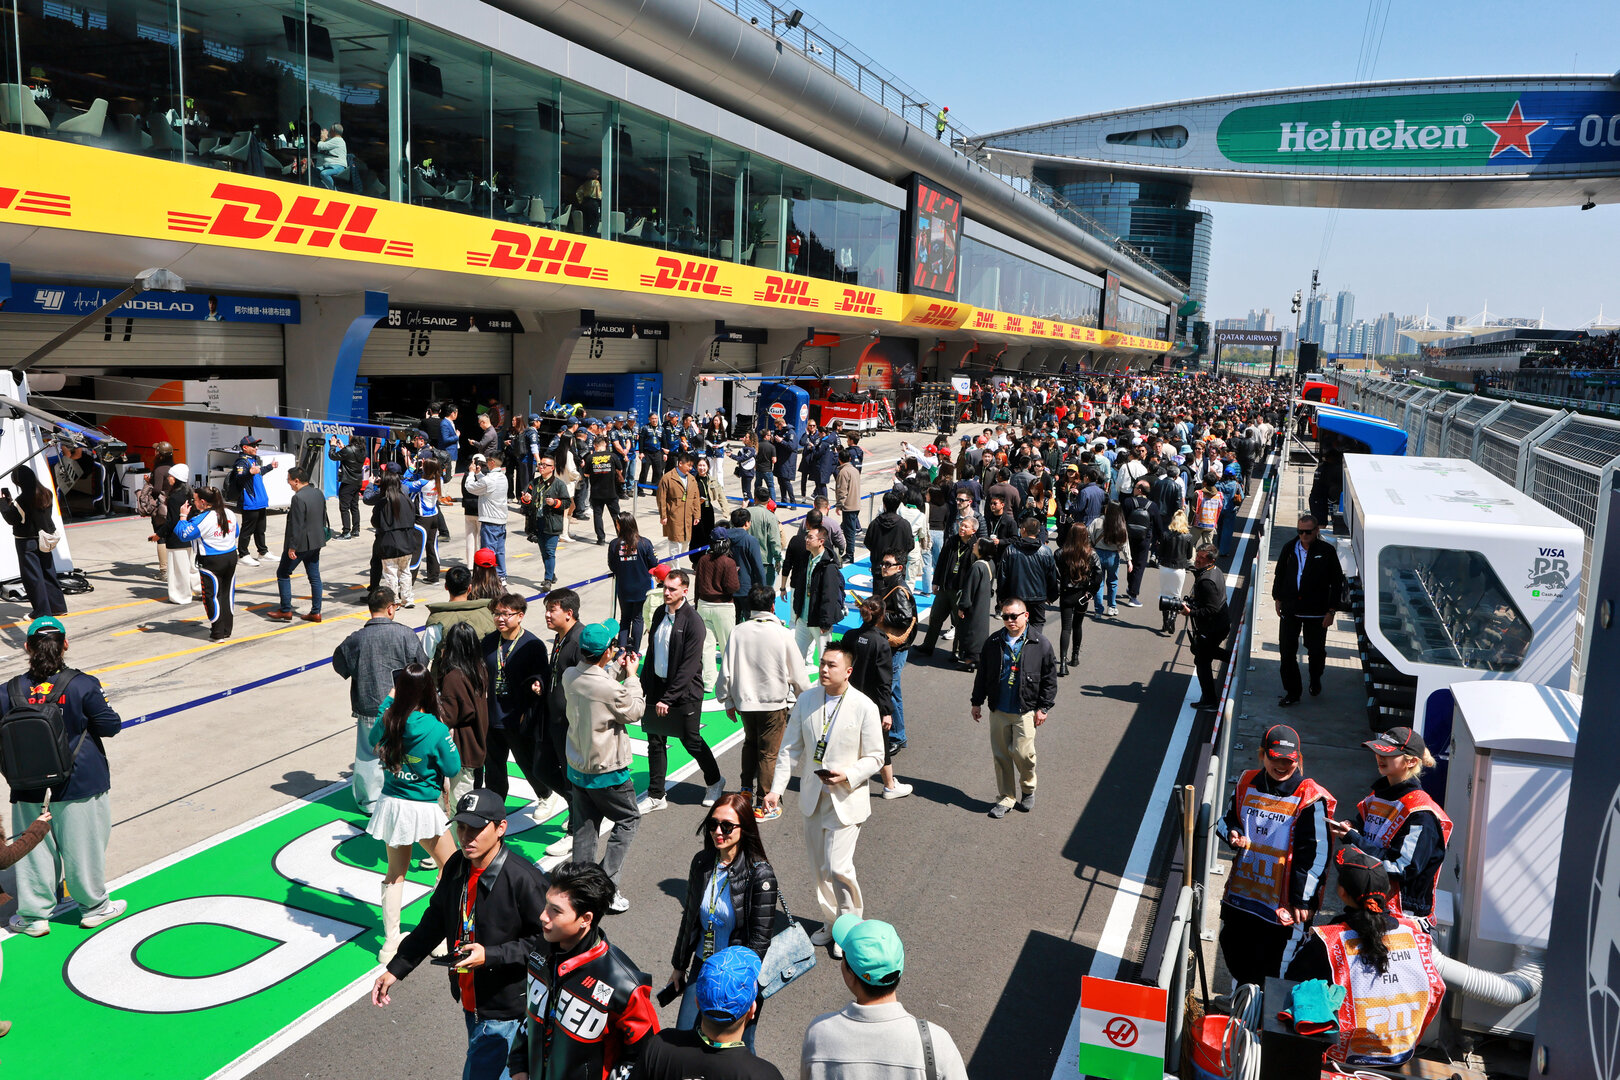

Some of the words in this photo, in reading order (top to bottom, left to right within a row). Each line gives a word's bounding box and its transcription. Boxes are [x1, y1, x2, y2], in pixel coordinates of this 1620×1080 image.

[1278, 120, 1470, 152] Heineken
[207, 183, 388, 254] DHL
[489, 228, 592, 278] DHL
[654, 256, 721, 296] DHL
[763, 275, 811, 306] DHL
[842, 288, 877, 314] DHL
[102, 298, 195, 313] LNDBLAD
[918, 303, 958, 327] DHL
[388, 310, 401, 325] 55
[422, 316, 457, 326] SAINZ
[975, 311, 994, 329] DHL
[1006, 316, 1022, 332] DHL
[408, 329, 432, 357] 16
[1219, 333, 1245, 341] QATAR
[302, 420, 355, 436] Airtasker
[1539, 547, 1565, 558] VISA
[1256, 826, 1269, 836] FIA
[1414, 933, 1437, 984] CHINA
[1382, 973, 1400, 984] FIA
[1365, 1001, 1420, 1033] PIT
